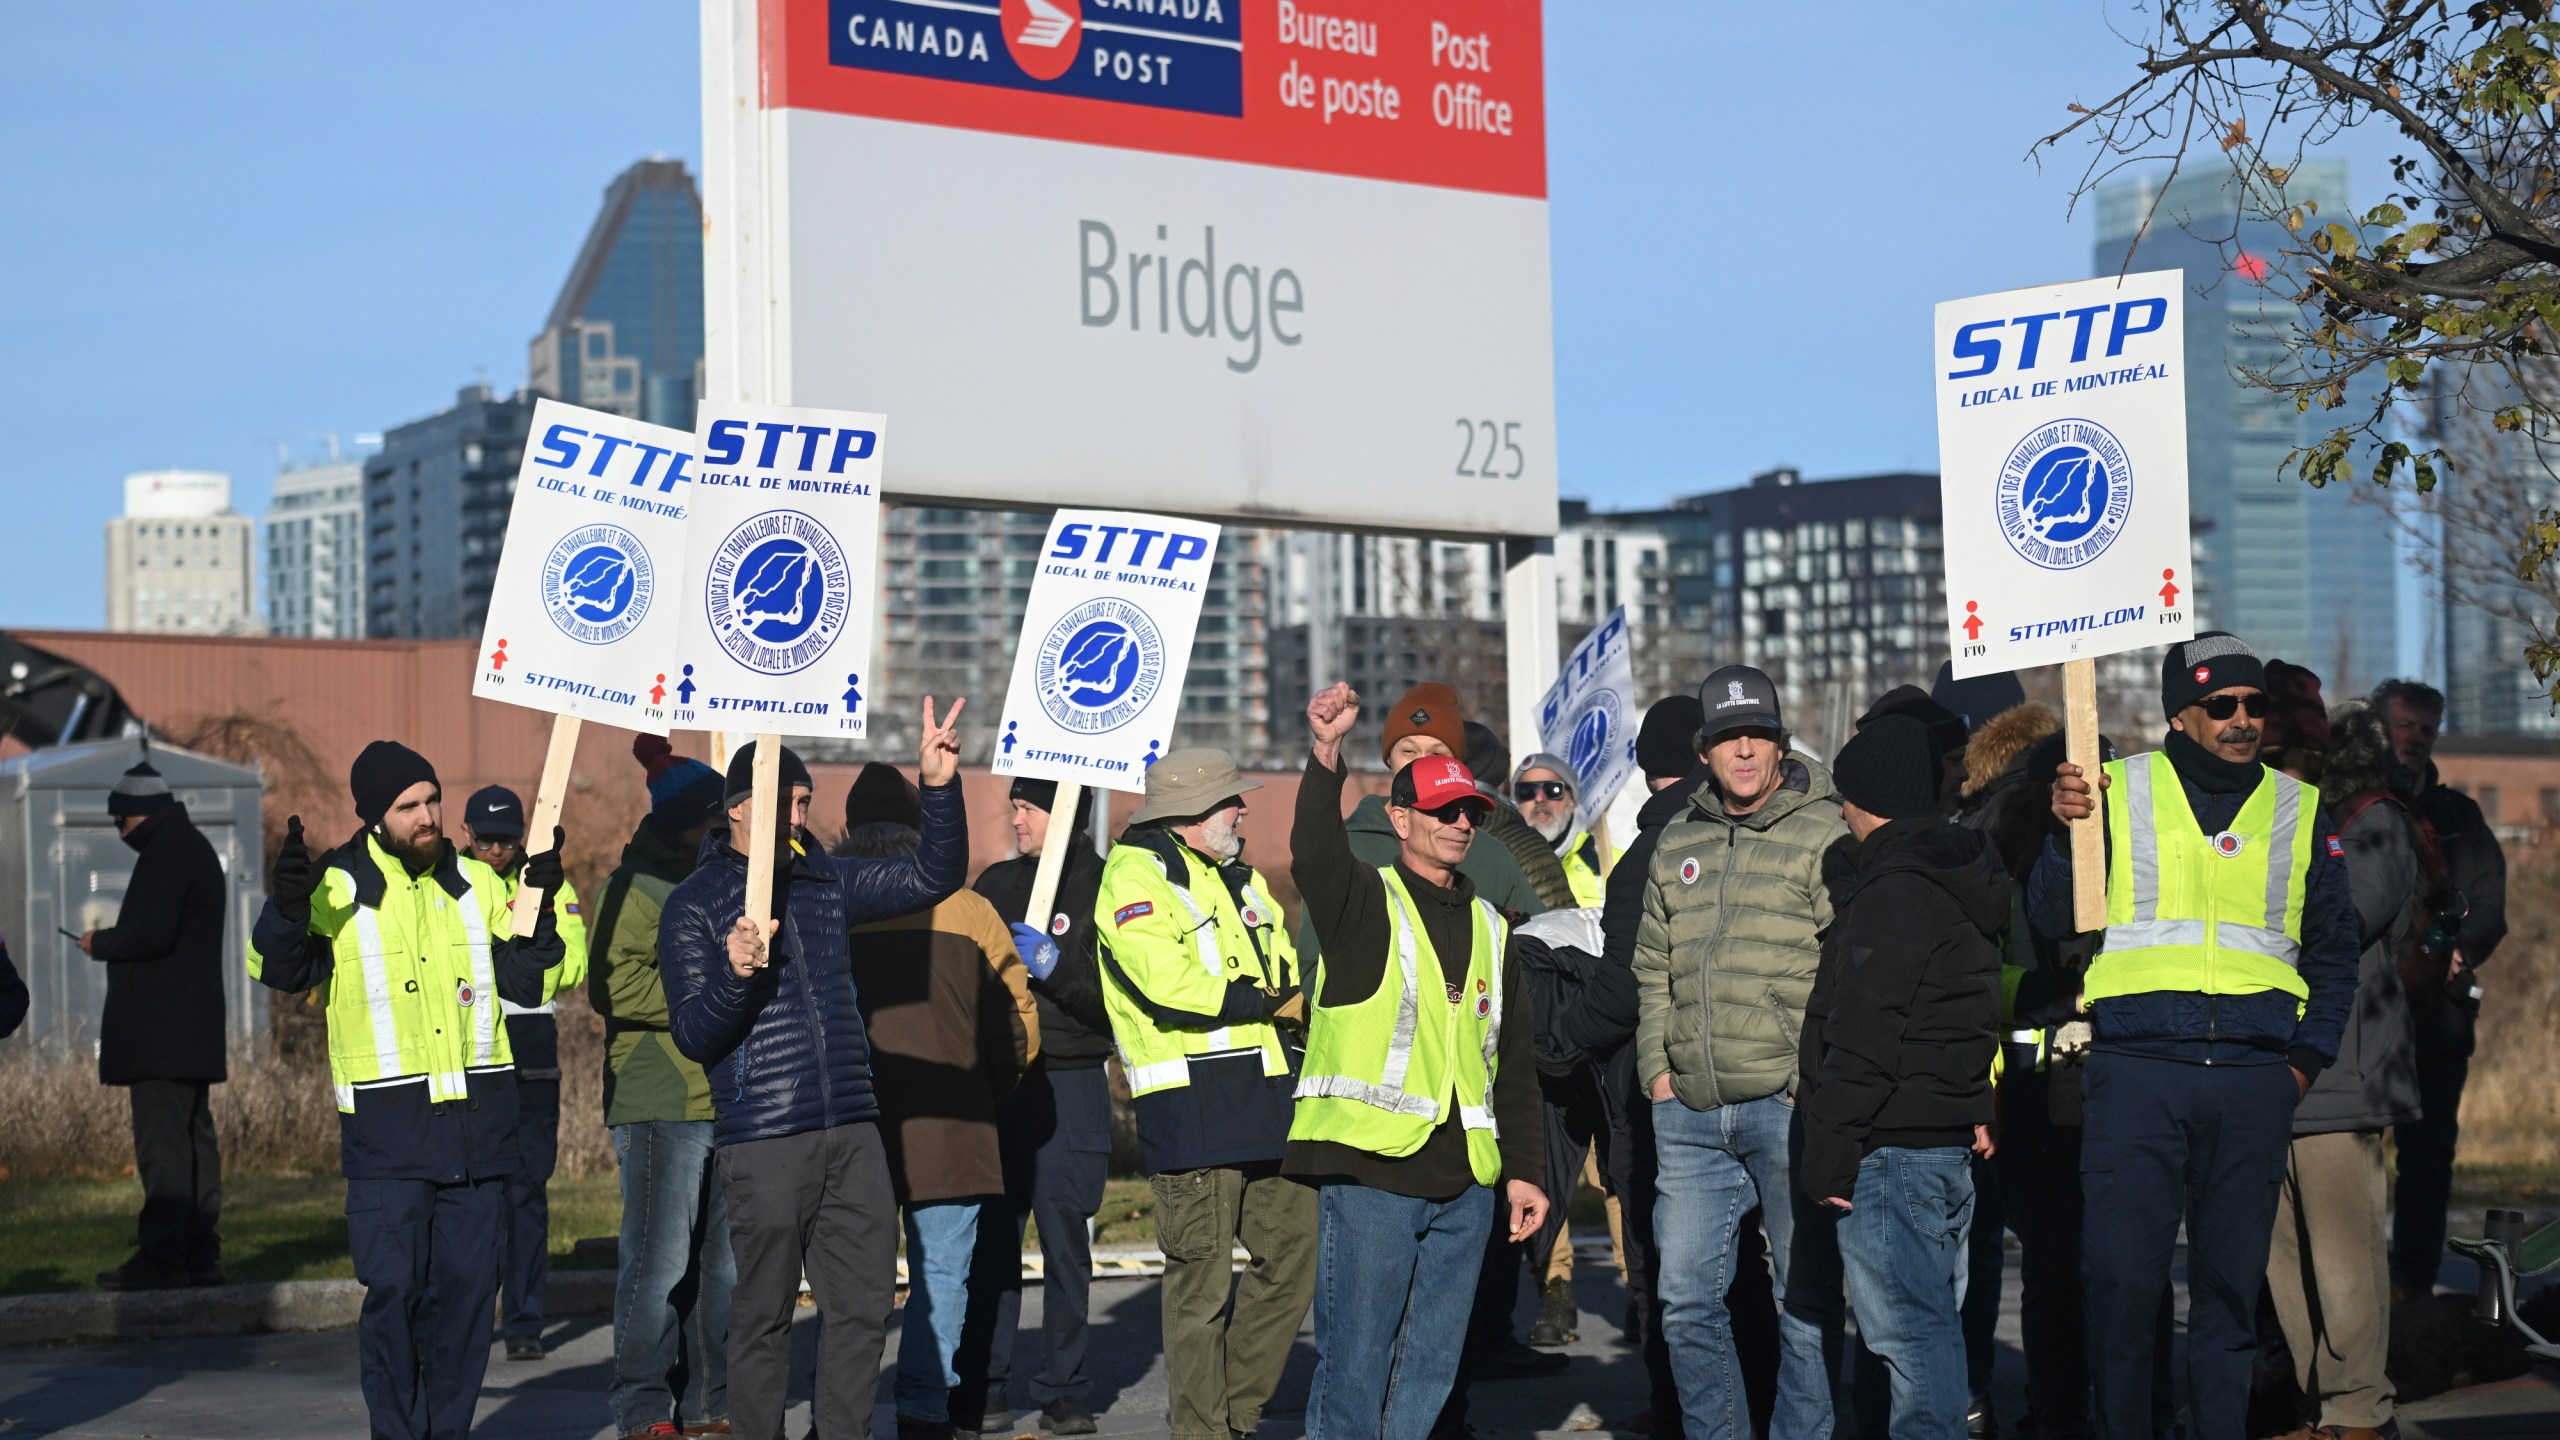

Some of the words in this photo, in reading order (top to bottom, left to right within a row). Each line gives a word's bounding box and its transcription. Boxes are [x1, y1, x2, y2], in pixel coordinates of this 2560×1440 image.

[848, 15, 989, 62] CANADA
[1278, 0, 1377, 57] Bureau
[1431, 21, 1491, 73] Post
[1094, 48, 1172, 85] POST
[1279, 59, 1315, 108] de
[1323, 77, 1400, 124] poste
[1433, 81, 1512, 136] Office
[1078, 218, 1304, 374] Bridge
[1948, 297, 2168, 380] STTP
[1960, 387, 2024, 408] LOCAL
[2031, 381, 2057, 397] DE
[2064, 363, 2169, 393] MONTRÉAL
[704, 419, 876, 474] STTP
[1455, 417, 1524, 480] 225
[2062, 425, 2070, 442] ET
[700, 473, 752, 488] LOCAL
[759, 476, 781, 490] DE
[787, 475, 872, 496] MONTRÉAL
[2002, 474, 2020, 490] DES
[2110, 466, 2127, 484] DES
[536, 476, 589, 499] LOCAL
[593, 488, 616, 505] DE
[619, 495, 688, 520] MONTRÉ
[2002, 494, 2025, 536] SYNDICAT
[2108, 486, 2127, 518] POSTES
[783, 516, 792, 533] ET
[1050, 523, 1208, 571] STTP
[2021, 536, 2050, 562] SECTION
[2049, 547, 2073, 565] LOCALE
[2074, 544, 2083, 562] DE
[2082, 524, 2114, 556] MONTRÉAL
[715, 557, 735, 576] DES
[827, 571, 844, 588] DES
[1044, 564, 1088, 580] LOCAL
[1094, 570, 1111, 581] DE
[1115, 572, 1197, 593] MONTRÉAL
[712, 577, 732, 626] SYNDICAT
[821, 592, 844, 628] POSTES
[2159, 611, 2182, 625] FTQ
[2009, 606, 2145, 642] STTPMTL.COM
[725, 628, 757, 661] SECTION
[754, 646, 780, 669] LOCALE
[782, 649, 790, 668] DE
[791, 631, 827, 665] MONTRÉAL
[1964, 644, 1986, 658] FTQ
[485, 673, 505, 685] FTQ
[524, 672, 636, 706] STTPMTL.COM
[1543, 617, 1621, 735] STTP
[644, 708, 663, 720] FTQ
[674, 709, 695, 721] FTQ
[708, 697, 829, 715] STTPMTL.COM
[840, 718, 862, 731] FTQ
[1024, 749, 1129, 772] STTPMTL.COM
